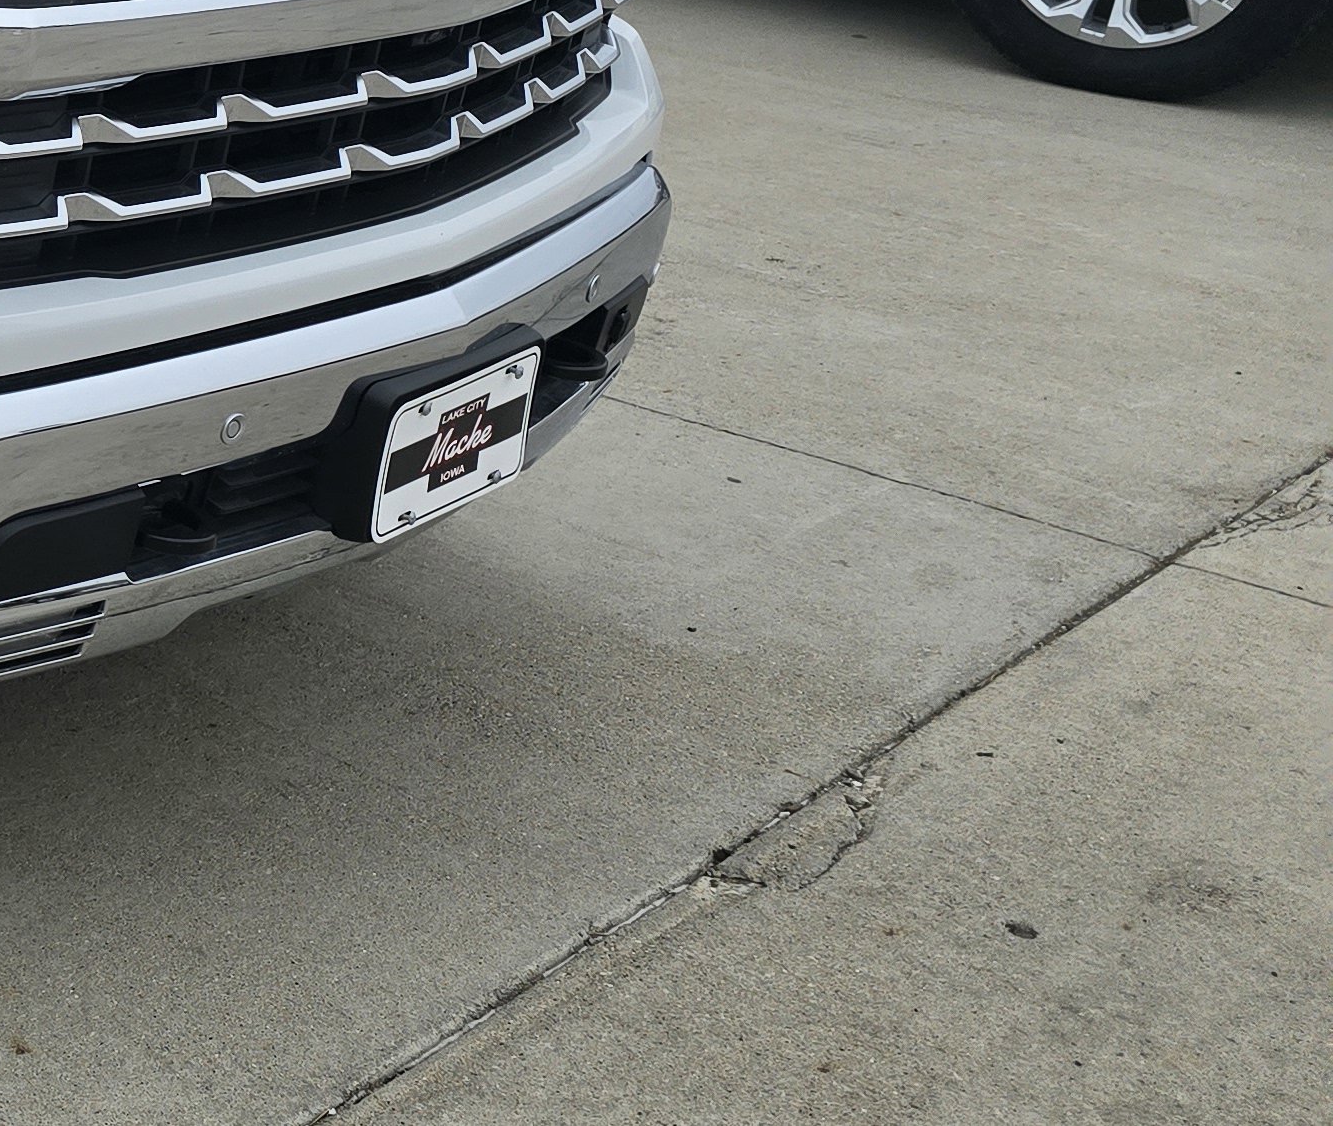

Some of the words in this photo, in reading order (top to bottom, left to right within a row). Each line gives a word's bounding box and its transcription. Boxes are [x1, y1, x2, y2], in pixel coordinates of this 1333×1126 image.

[441, 407, 466, 425] LAKE
[466, 397, 488, 415] CITY
[421, 413, 494, 473] Macke
[440, 464, 465, 483] IOWA
